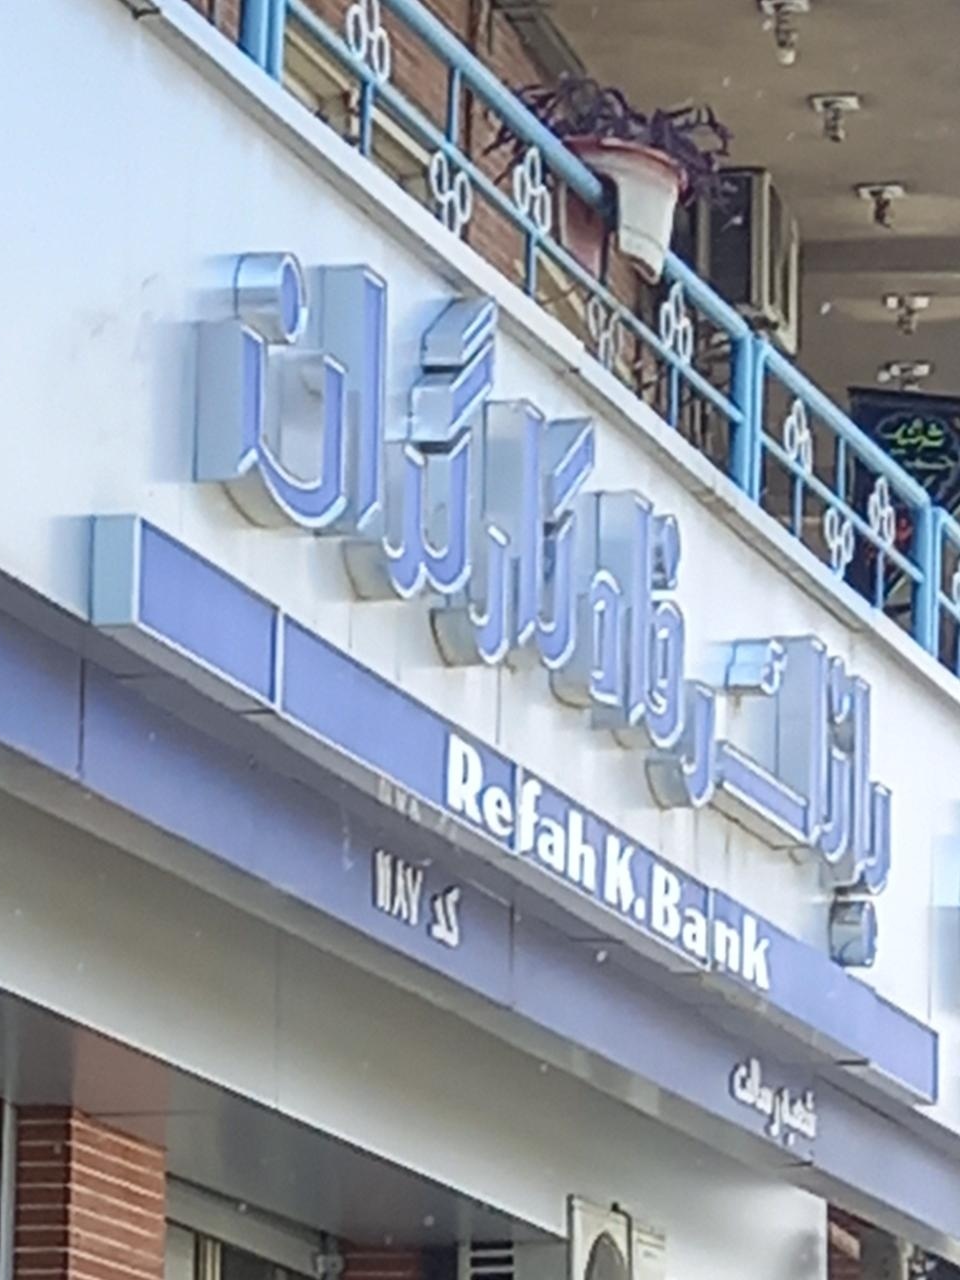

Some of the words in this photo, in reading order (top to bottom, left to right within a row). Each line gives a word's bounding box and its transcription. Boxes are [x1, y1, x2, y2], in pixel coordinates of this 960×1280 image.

[230, 252, 595, 670] کارگران
[590, 492, 717, 808] رفاه
[446, 733, 597, 896] Refah
